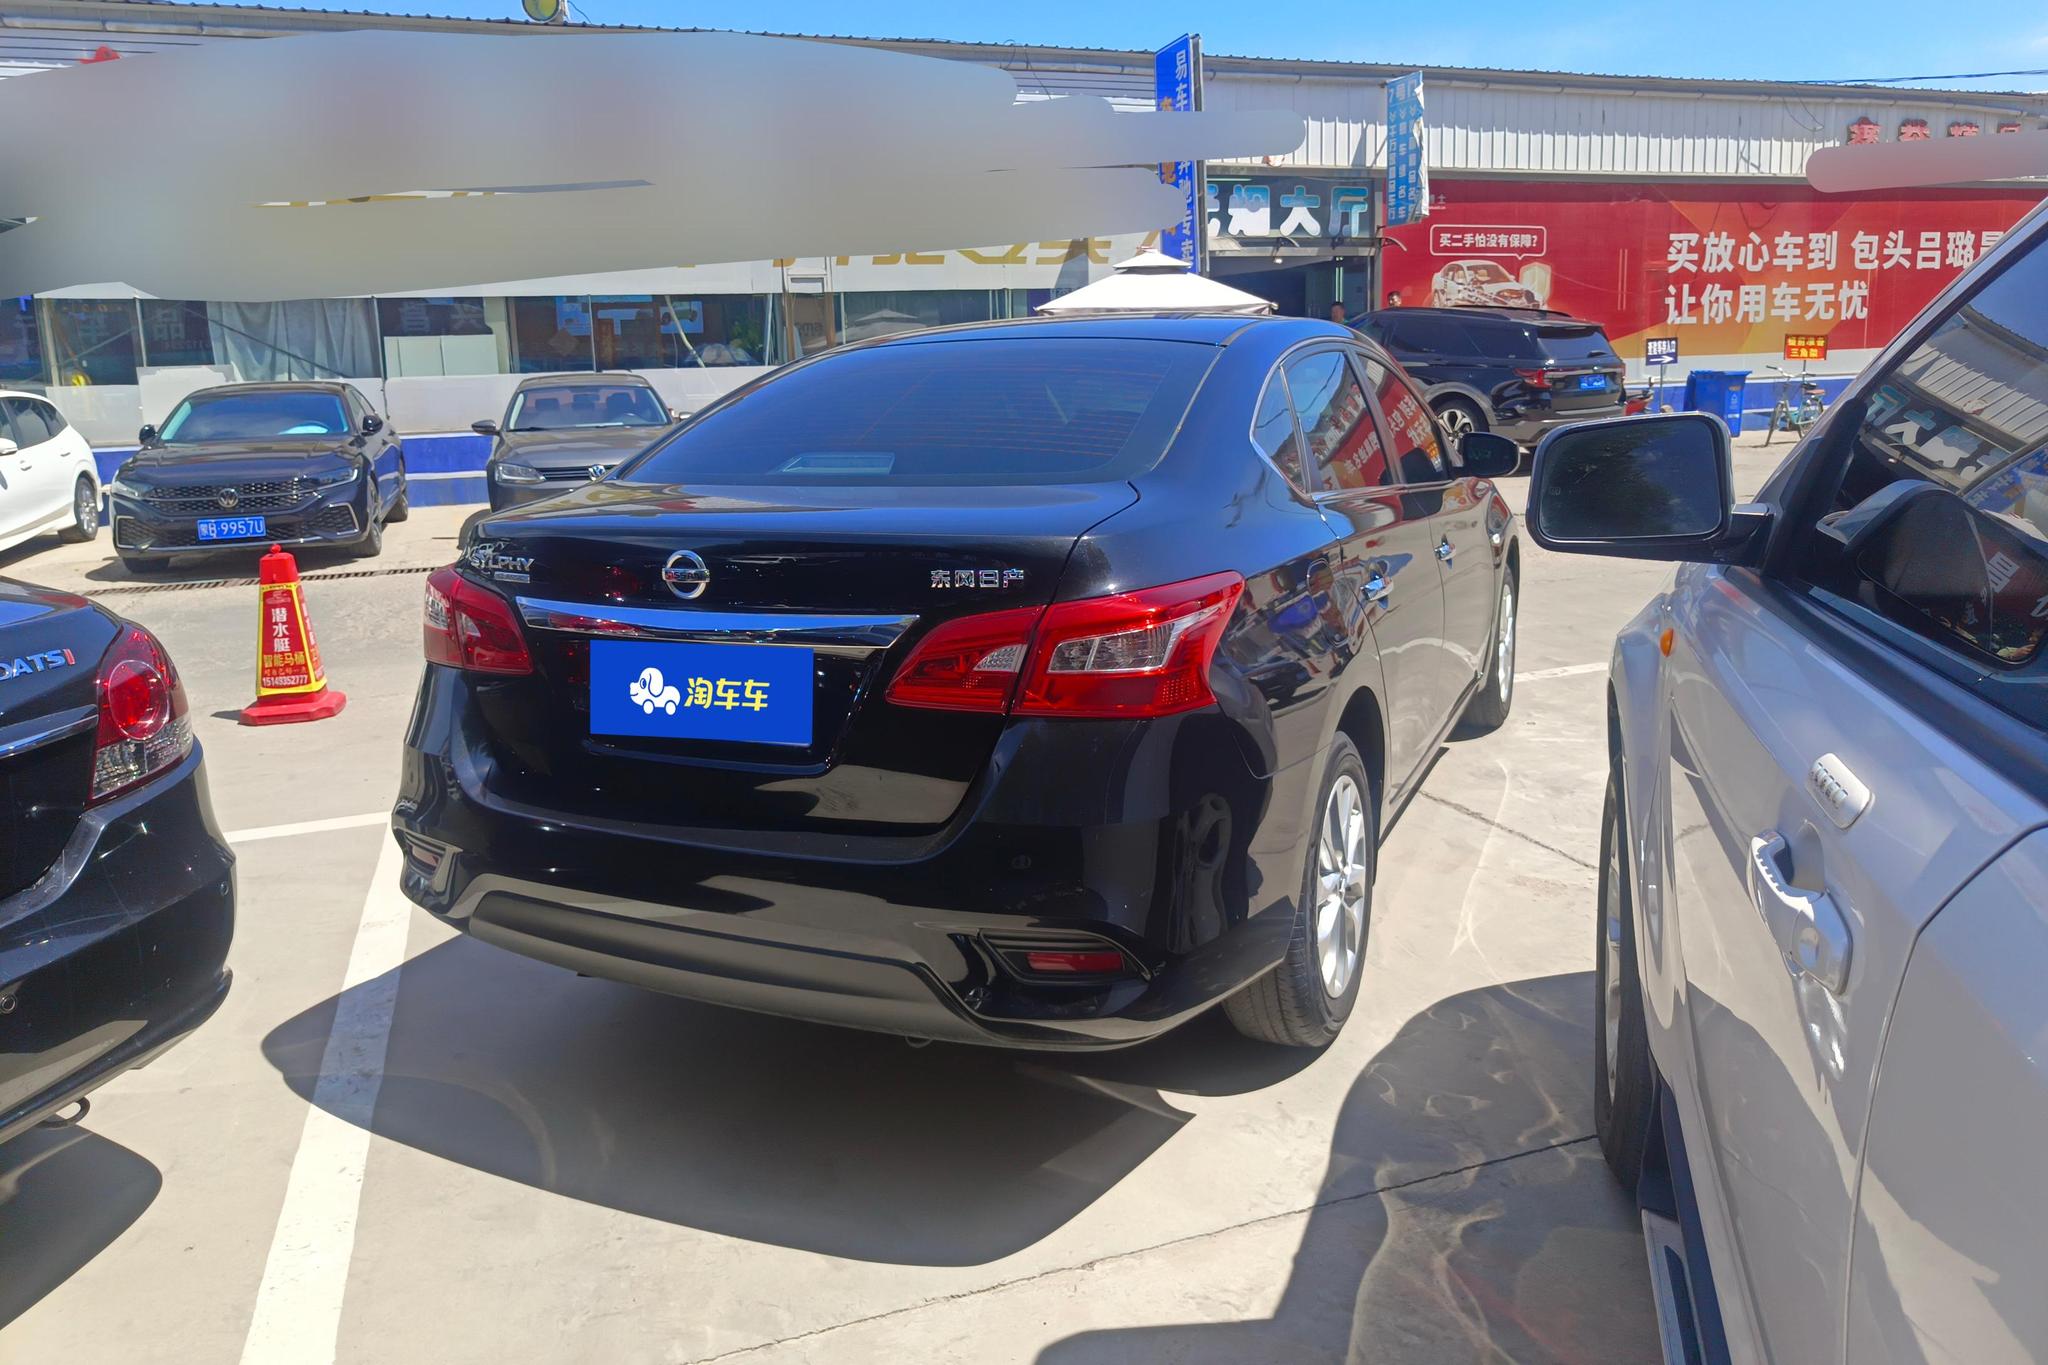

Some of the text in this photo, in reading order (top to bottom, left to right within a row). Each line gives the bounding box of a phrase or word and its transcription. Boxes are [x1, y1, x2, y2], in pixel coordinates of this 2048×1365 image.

[1666, 231, 1839, 274] 买放心车到
[1665, 279, 1869, 325] 让你用车无忧
[470, 554, 536, 573] SYLPHY
[930, 568, 1024, 588] 东风日产
[271, 607, 291, 652] 潜水艇
[263, 651, 306, 668] 智能马桶
